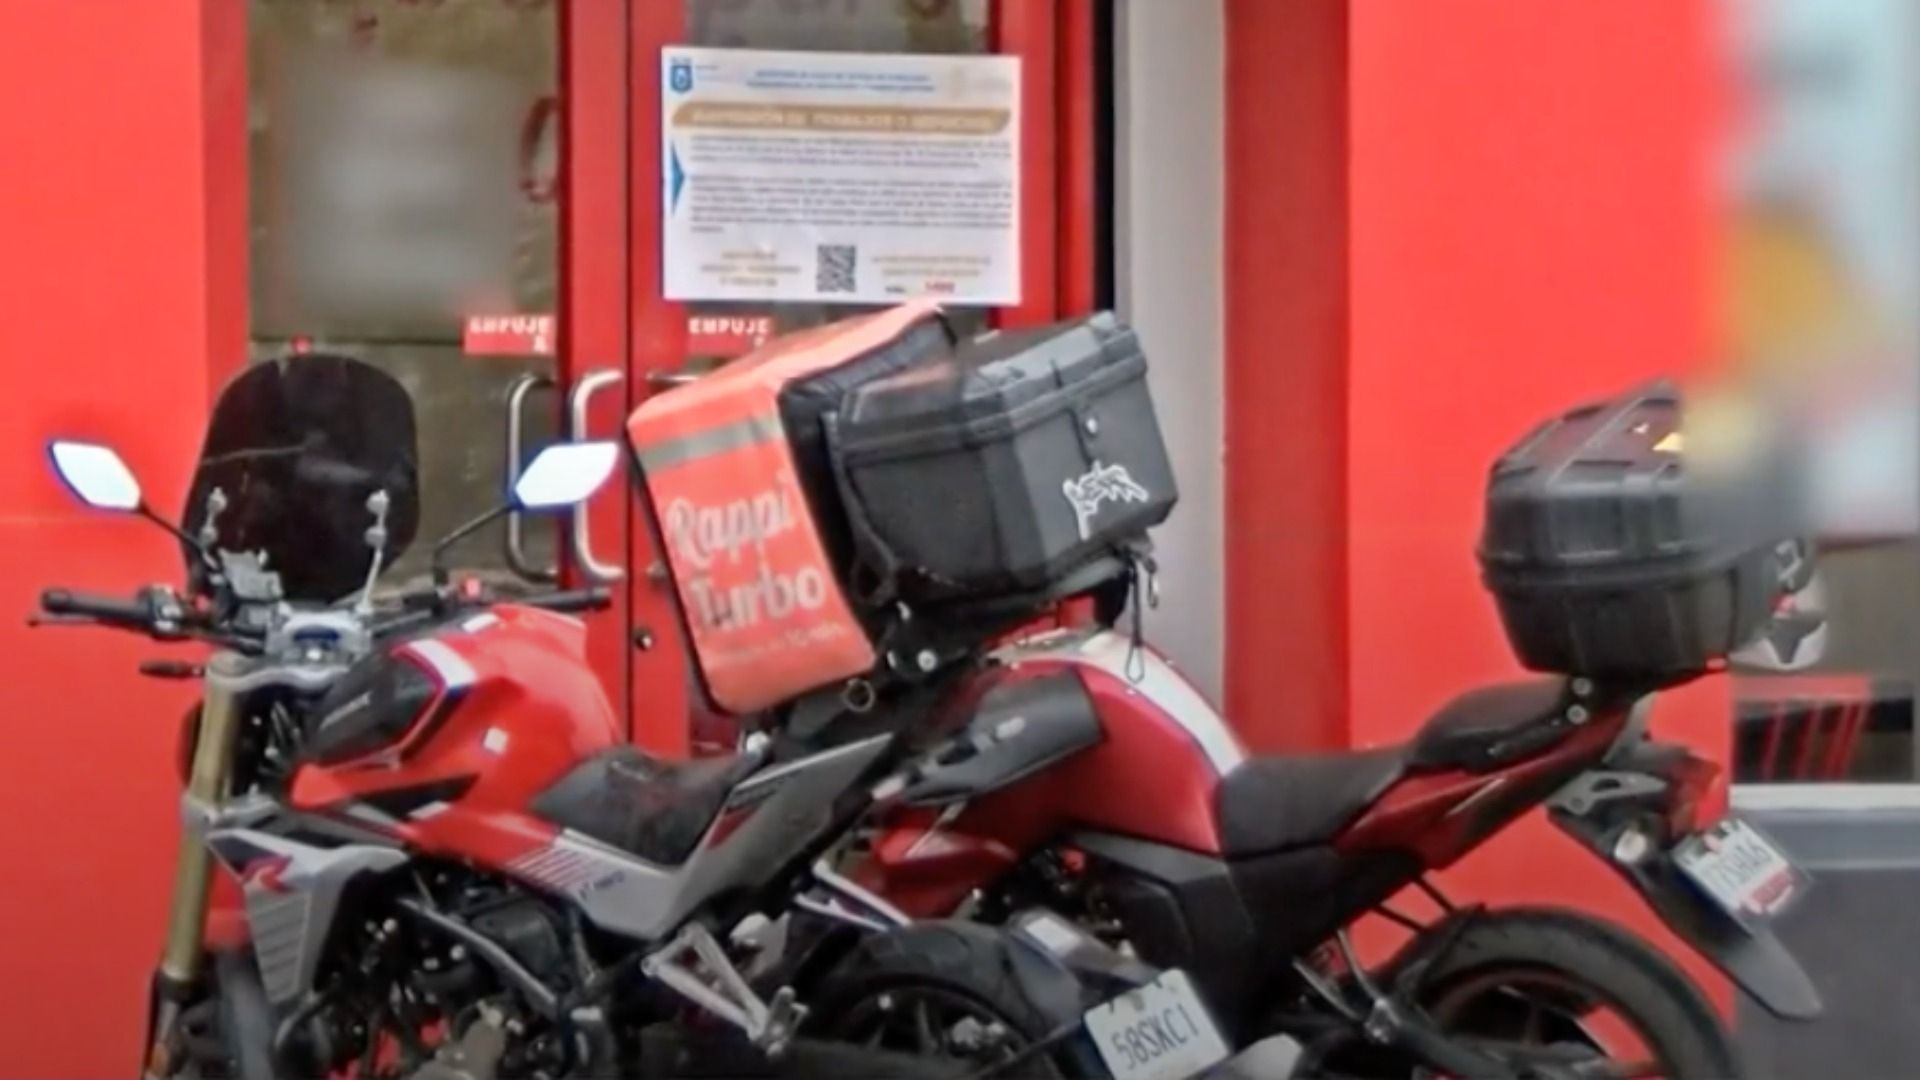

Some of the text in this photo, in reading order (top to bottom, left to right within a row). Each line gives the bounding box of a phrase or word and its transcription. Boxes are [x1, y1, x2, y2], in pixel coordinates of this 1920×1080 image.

[688, 317, 770, 334] EMPUJE
[665, 468, 794, 567] Rappi
[687, 564, 825, 629] Turbo
